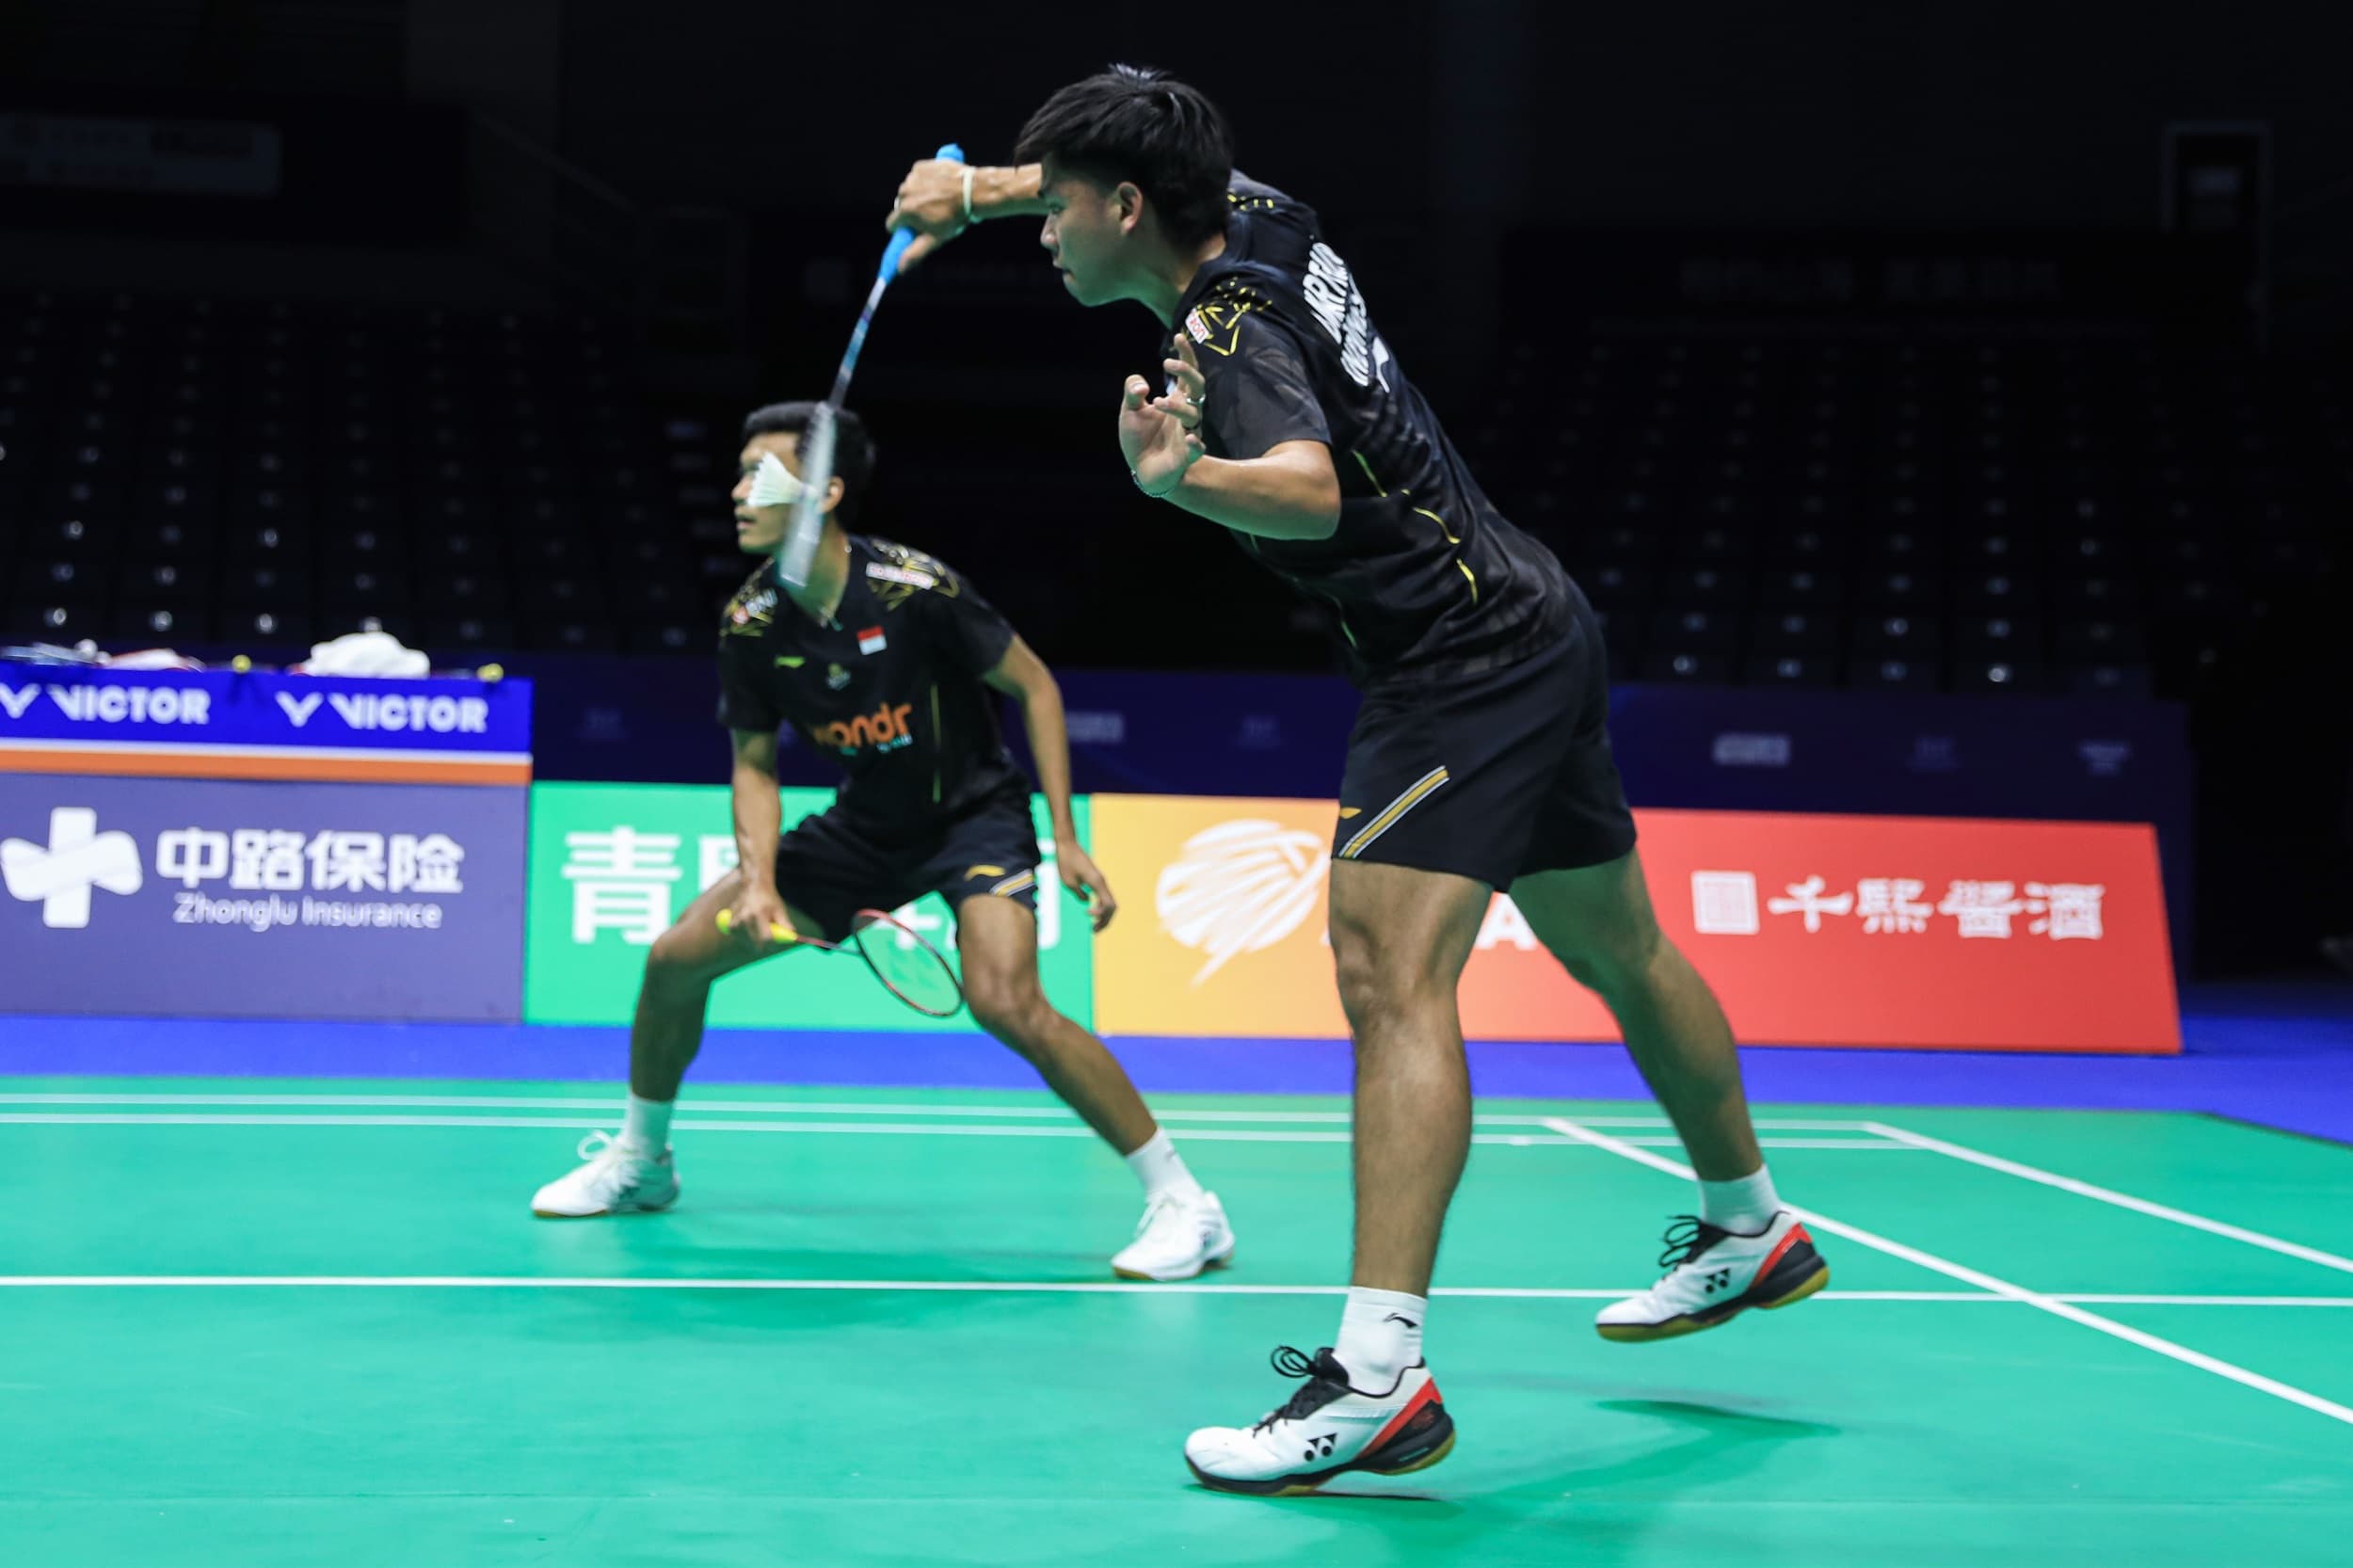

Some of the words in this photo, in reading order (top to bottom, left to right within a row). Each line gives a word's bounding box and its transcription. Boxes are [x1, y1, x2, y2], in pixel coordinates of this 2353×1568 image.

[47, 684, 211, 725] VICTOR
[328, 693, 489, 733] VICTOR
[155, 825, 465, 894] 中路保险
[172, 890, 298, 933] Zhonglu
[301, 895, 443, 929] Insurance
